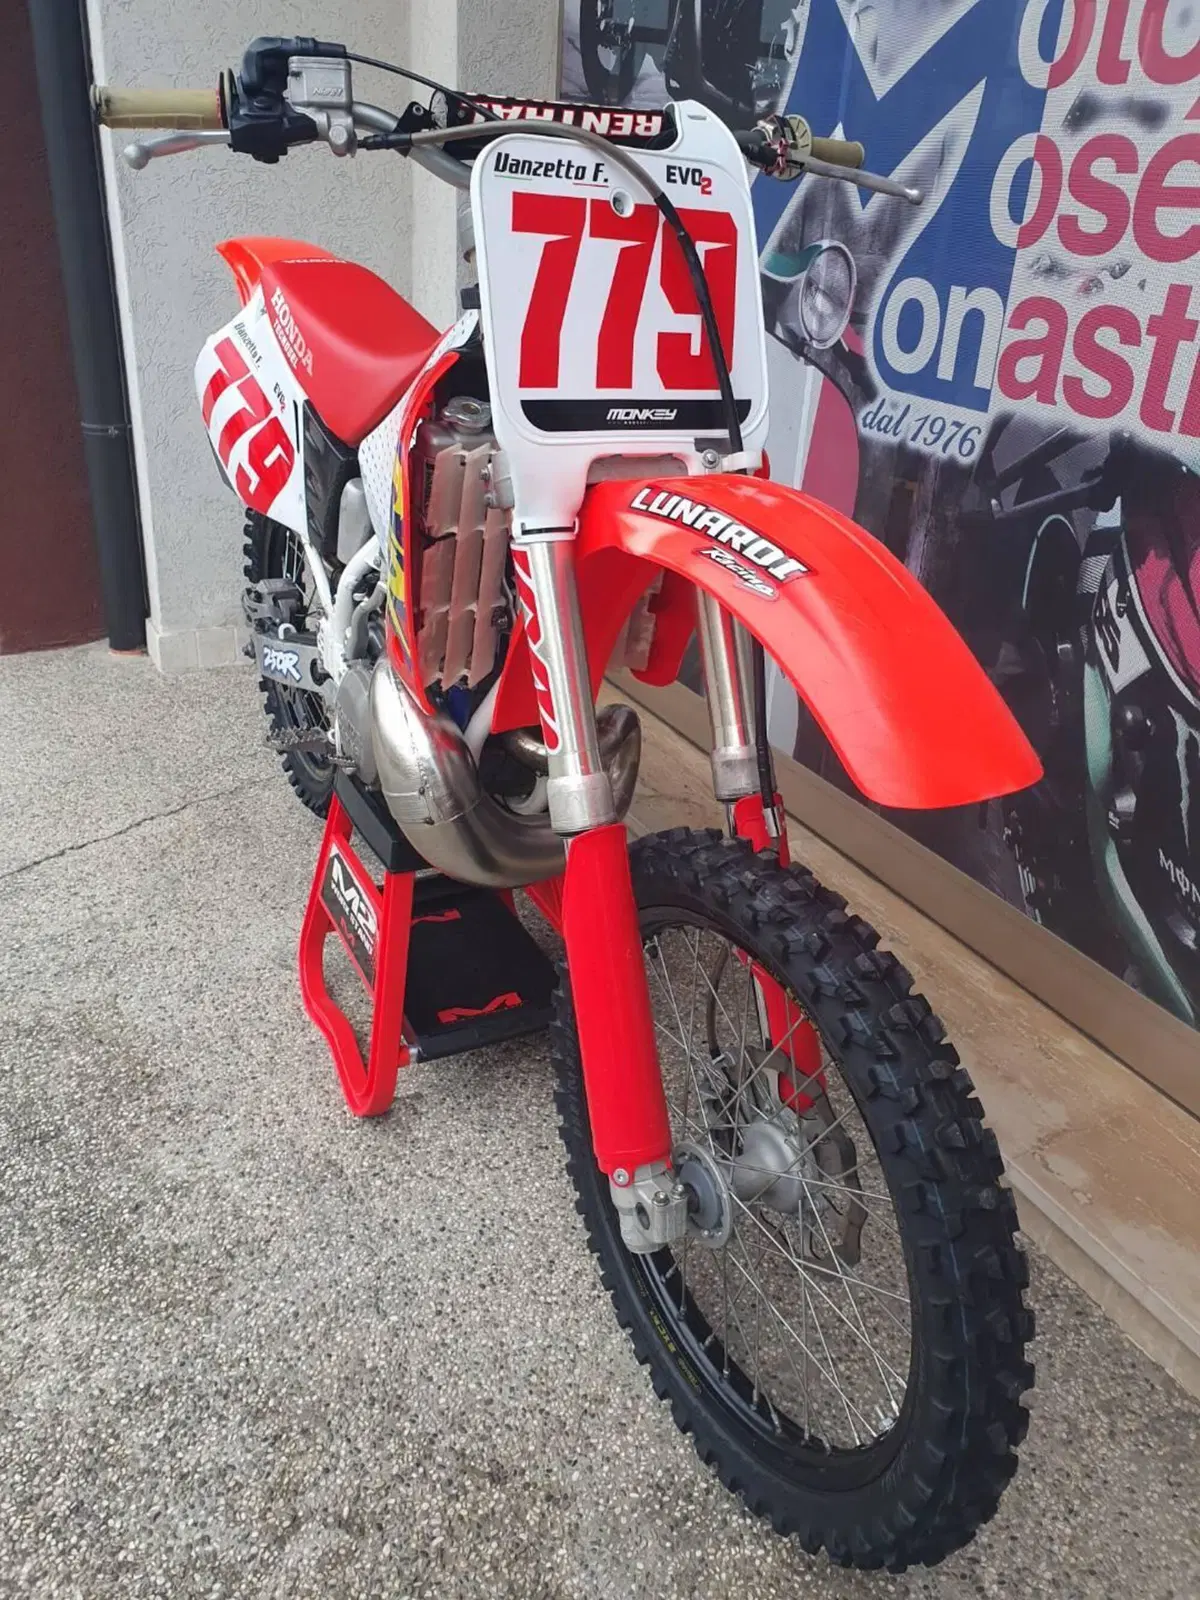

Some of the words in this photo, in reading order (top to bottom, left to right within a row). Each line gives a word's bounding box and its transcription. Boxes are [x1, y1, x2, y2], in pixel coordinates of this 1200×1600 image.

[592, 162, 609, 183] F.
[270, 286, 314, 377] HONDA
[511, 190, 738, 391] 779
[202, 336, 296, 515] 779
[606, 408, 678, 420] MONKEY
[861, 398, 902, 436] dal
[909, 415, 983, 459] 1976
[630, 487, 808, 581] LUNARDI
